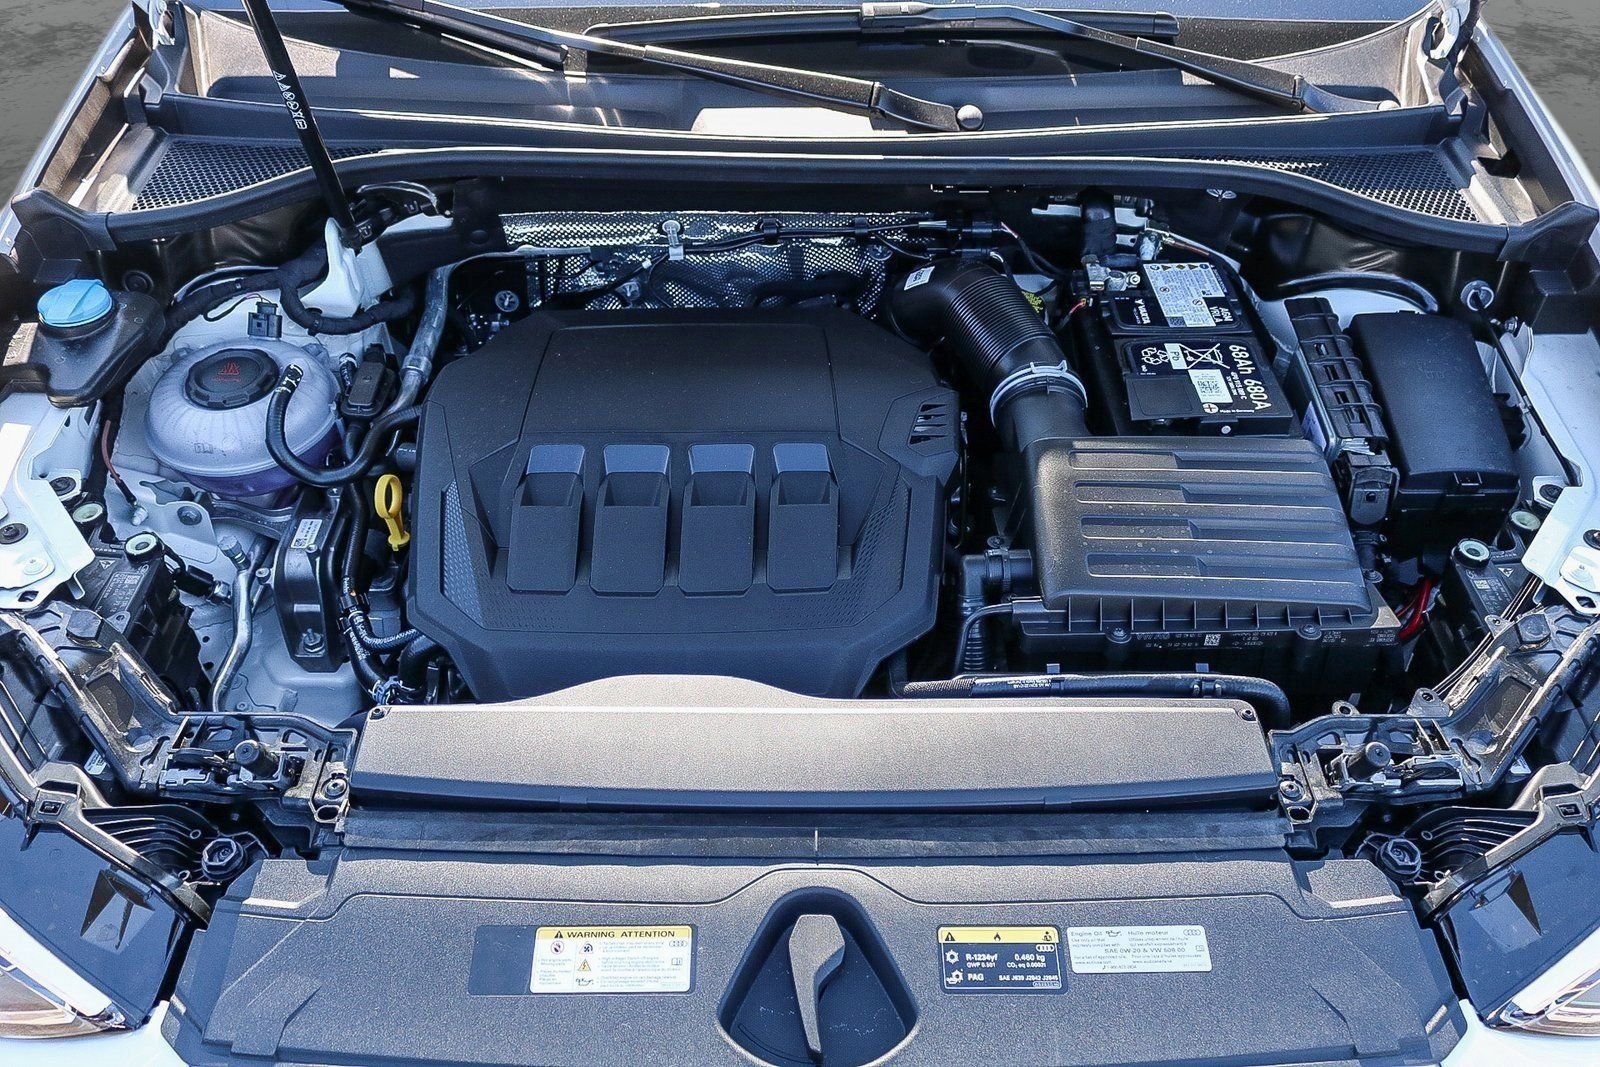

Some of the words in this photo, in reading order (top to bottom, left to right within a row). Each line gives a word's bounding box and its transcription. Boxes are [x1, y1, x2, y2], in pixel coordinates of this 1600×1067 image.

[1209, 305, 1223, 323] VRLA
[1219, 307, 1234, 322] AGM
[1170, 351, 1181, 362] Pb
[1229, 344, 1256, 375] 68Ah
[1243, 378, 1272, 410] 680A
[621, 930, 676, 938] ATTENTION
[965, 953, 998, 962] R-1234yf
[1036, 953, 1046, 962] kg
[967, 973, 984, 981] PAG
